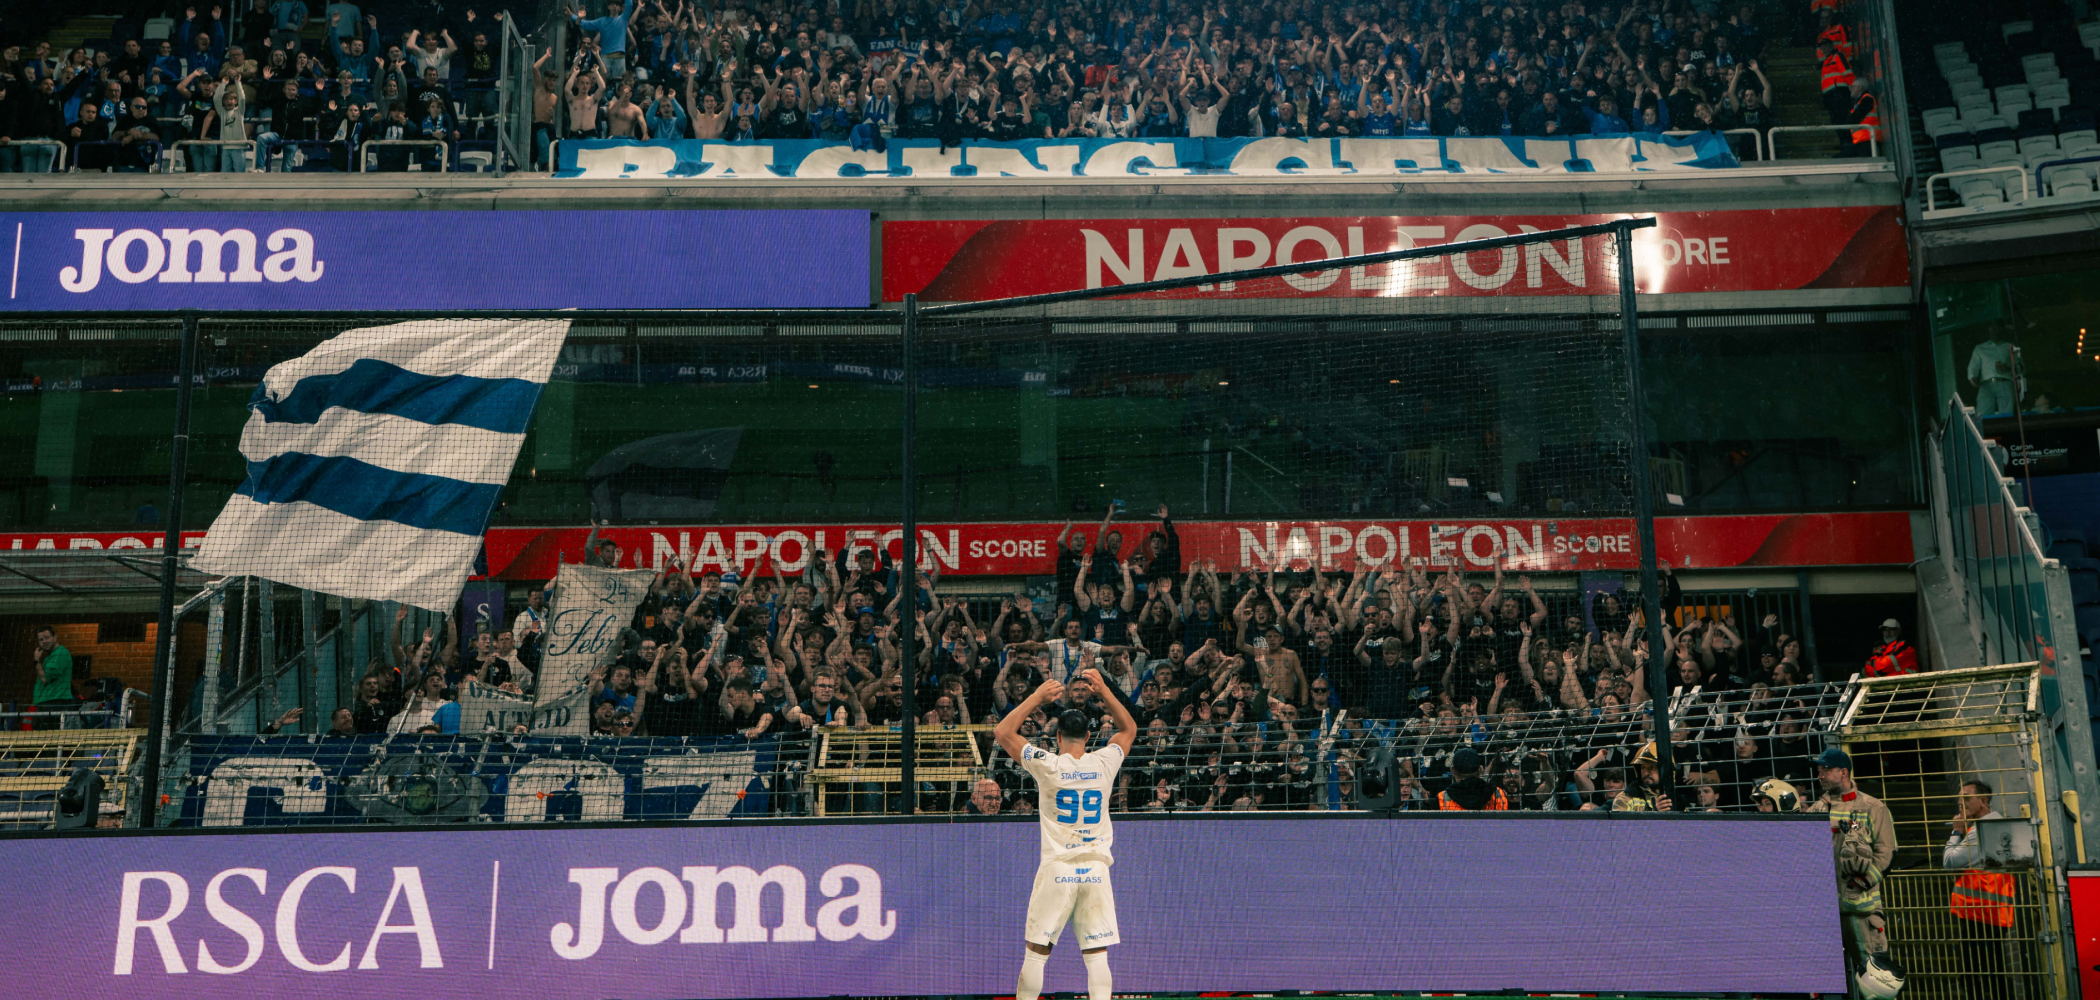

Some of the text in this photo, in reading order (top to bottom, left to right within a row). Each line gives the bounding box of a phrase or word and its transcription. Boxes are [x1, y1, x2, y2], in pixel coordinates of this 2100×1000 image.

[870, 40, 895, 50] FAN
[1079, 224, 1586, 291] NAPOLEON
[2043, 447, 2068, 455] Center
[969, 540, 1047, 559] SCORE
[1236, 525, 1631, 570] NAPOLEON SCORE
[1056, 789, 1103, 824] 99
[113, 866, 444, 975] RSCA
